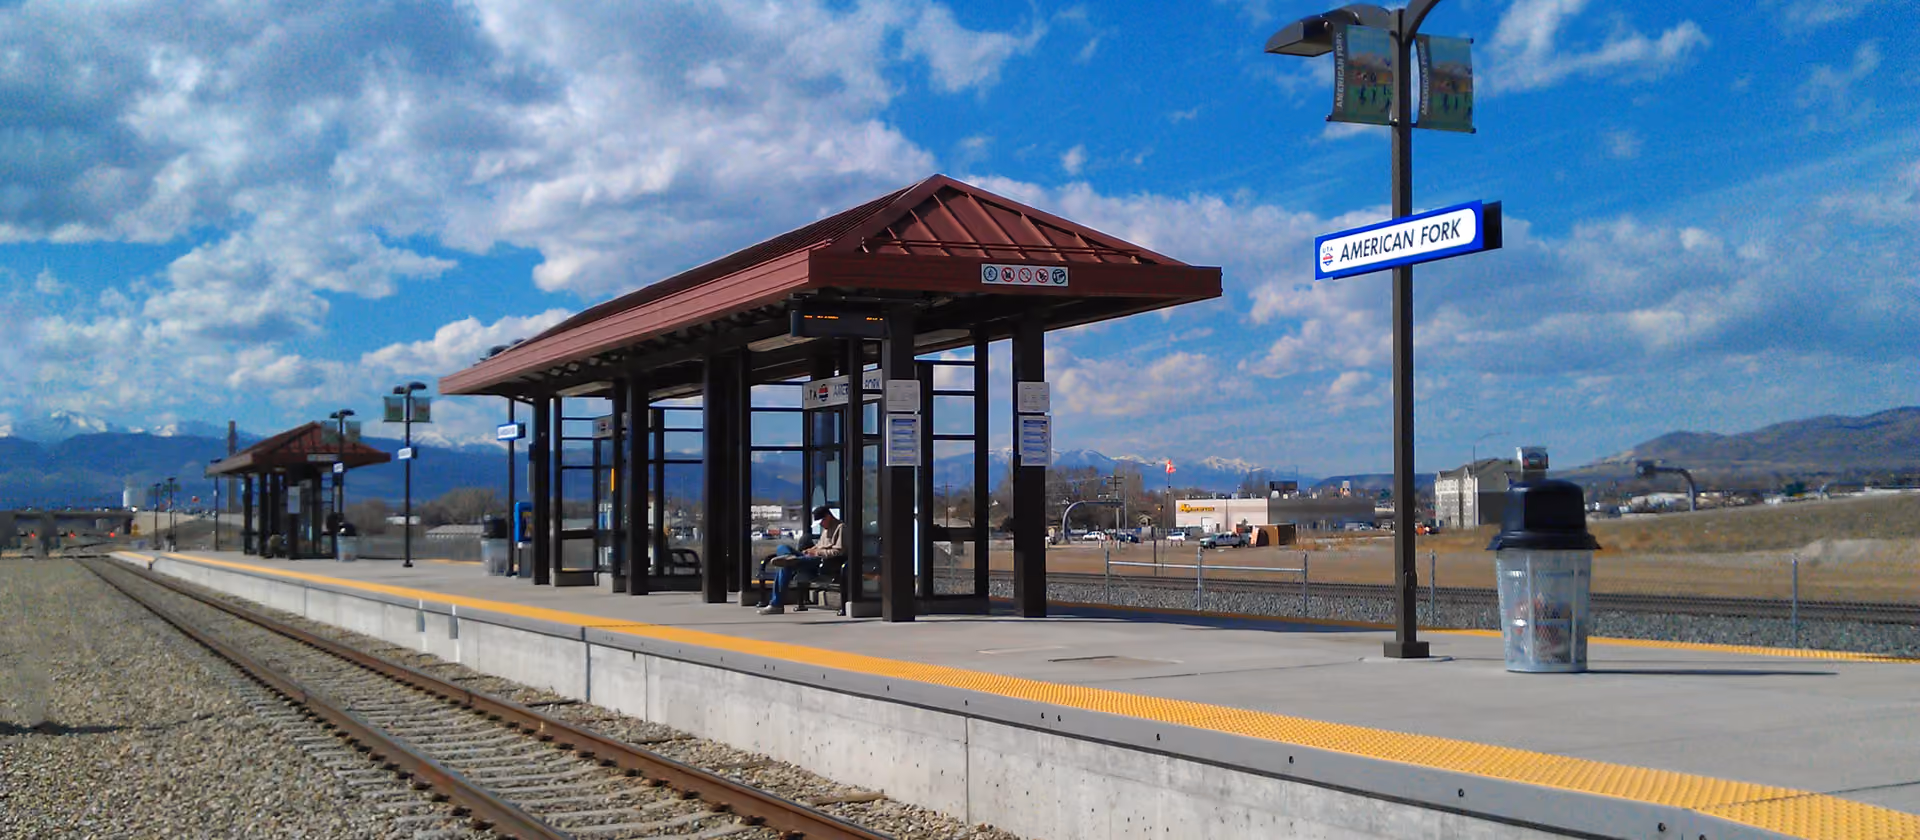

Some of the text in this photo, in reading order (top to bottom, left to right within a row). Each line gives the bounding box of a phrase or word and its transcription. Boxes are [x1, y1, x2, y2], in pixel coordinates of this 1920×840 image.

[1336, 58, 1345, 108] AMERICAN
[1322, 246, 1334, 254] UTA
[1339, 217, 1462, 263] AMERICAN FORK
